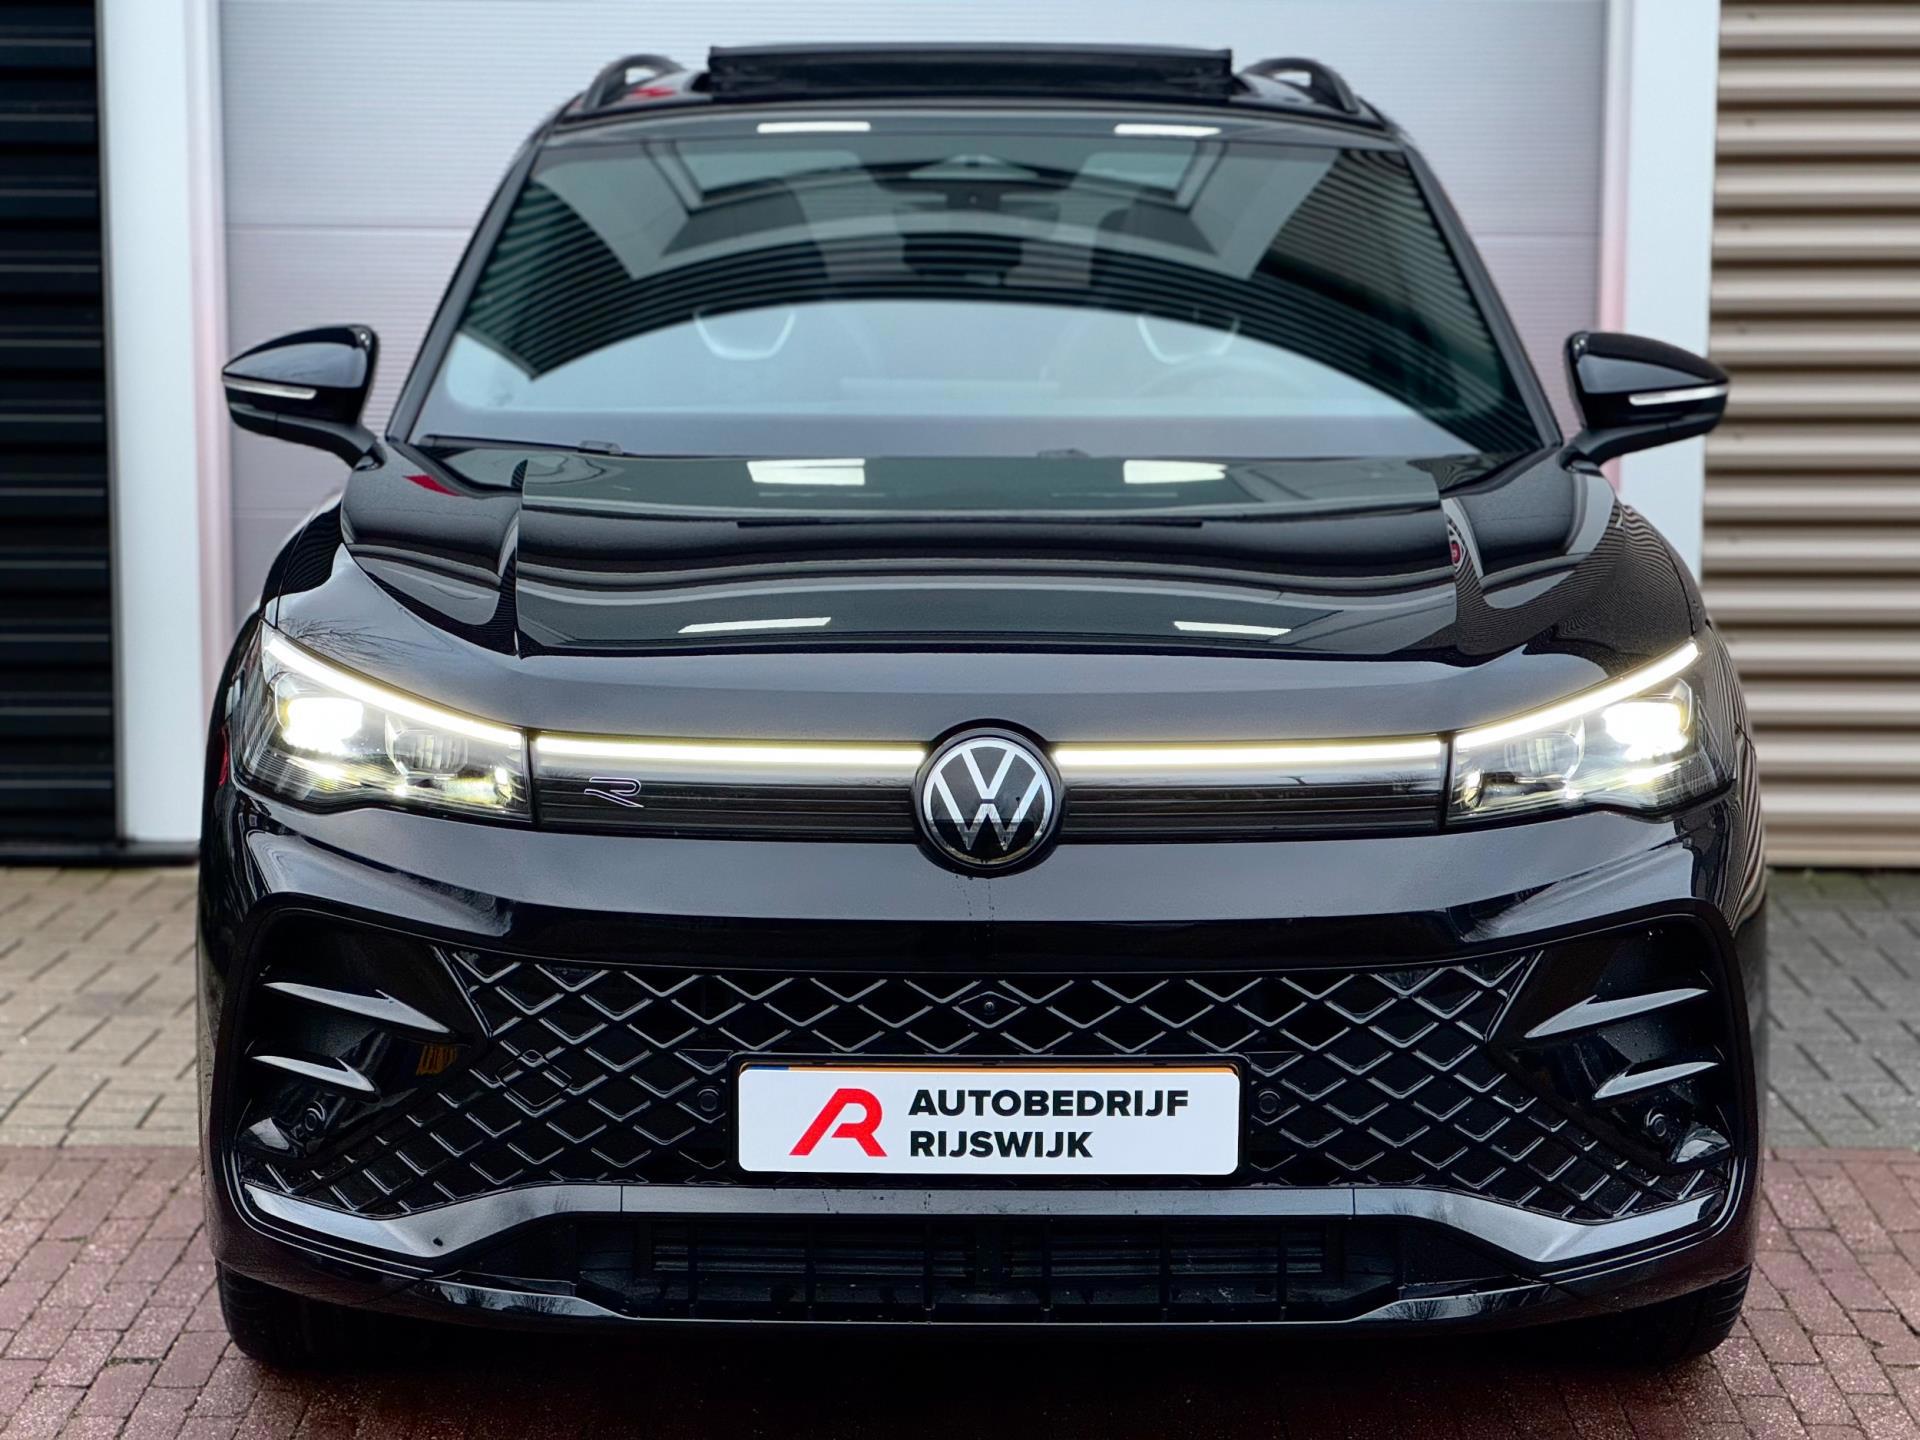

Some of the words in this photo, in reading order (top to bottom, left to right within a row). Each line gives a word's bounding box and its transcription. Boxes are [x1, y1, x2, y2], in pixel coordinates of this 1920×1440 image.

[584, 776, 644, 808] R
[928, 741, 1050, 856] VW
[908, 1089, 1189, 1117] AUTOBEDRIJF
[910, 1130, 1093, 1158] RIJSWIJK
